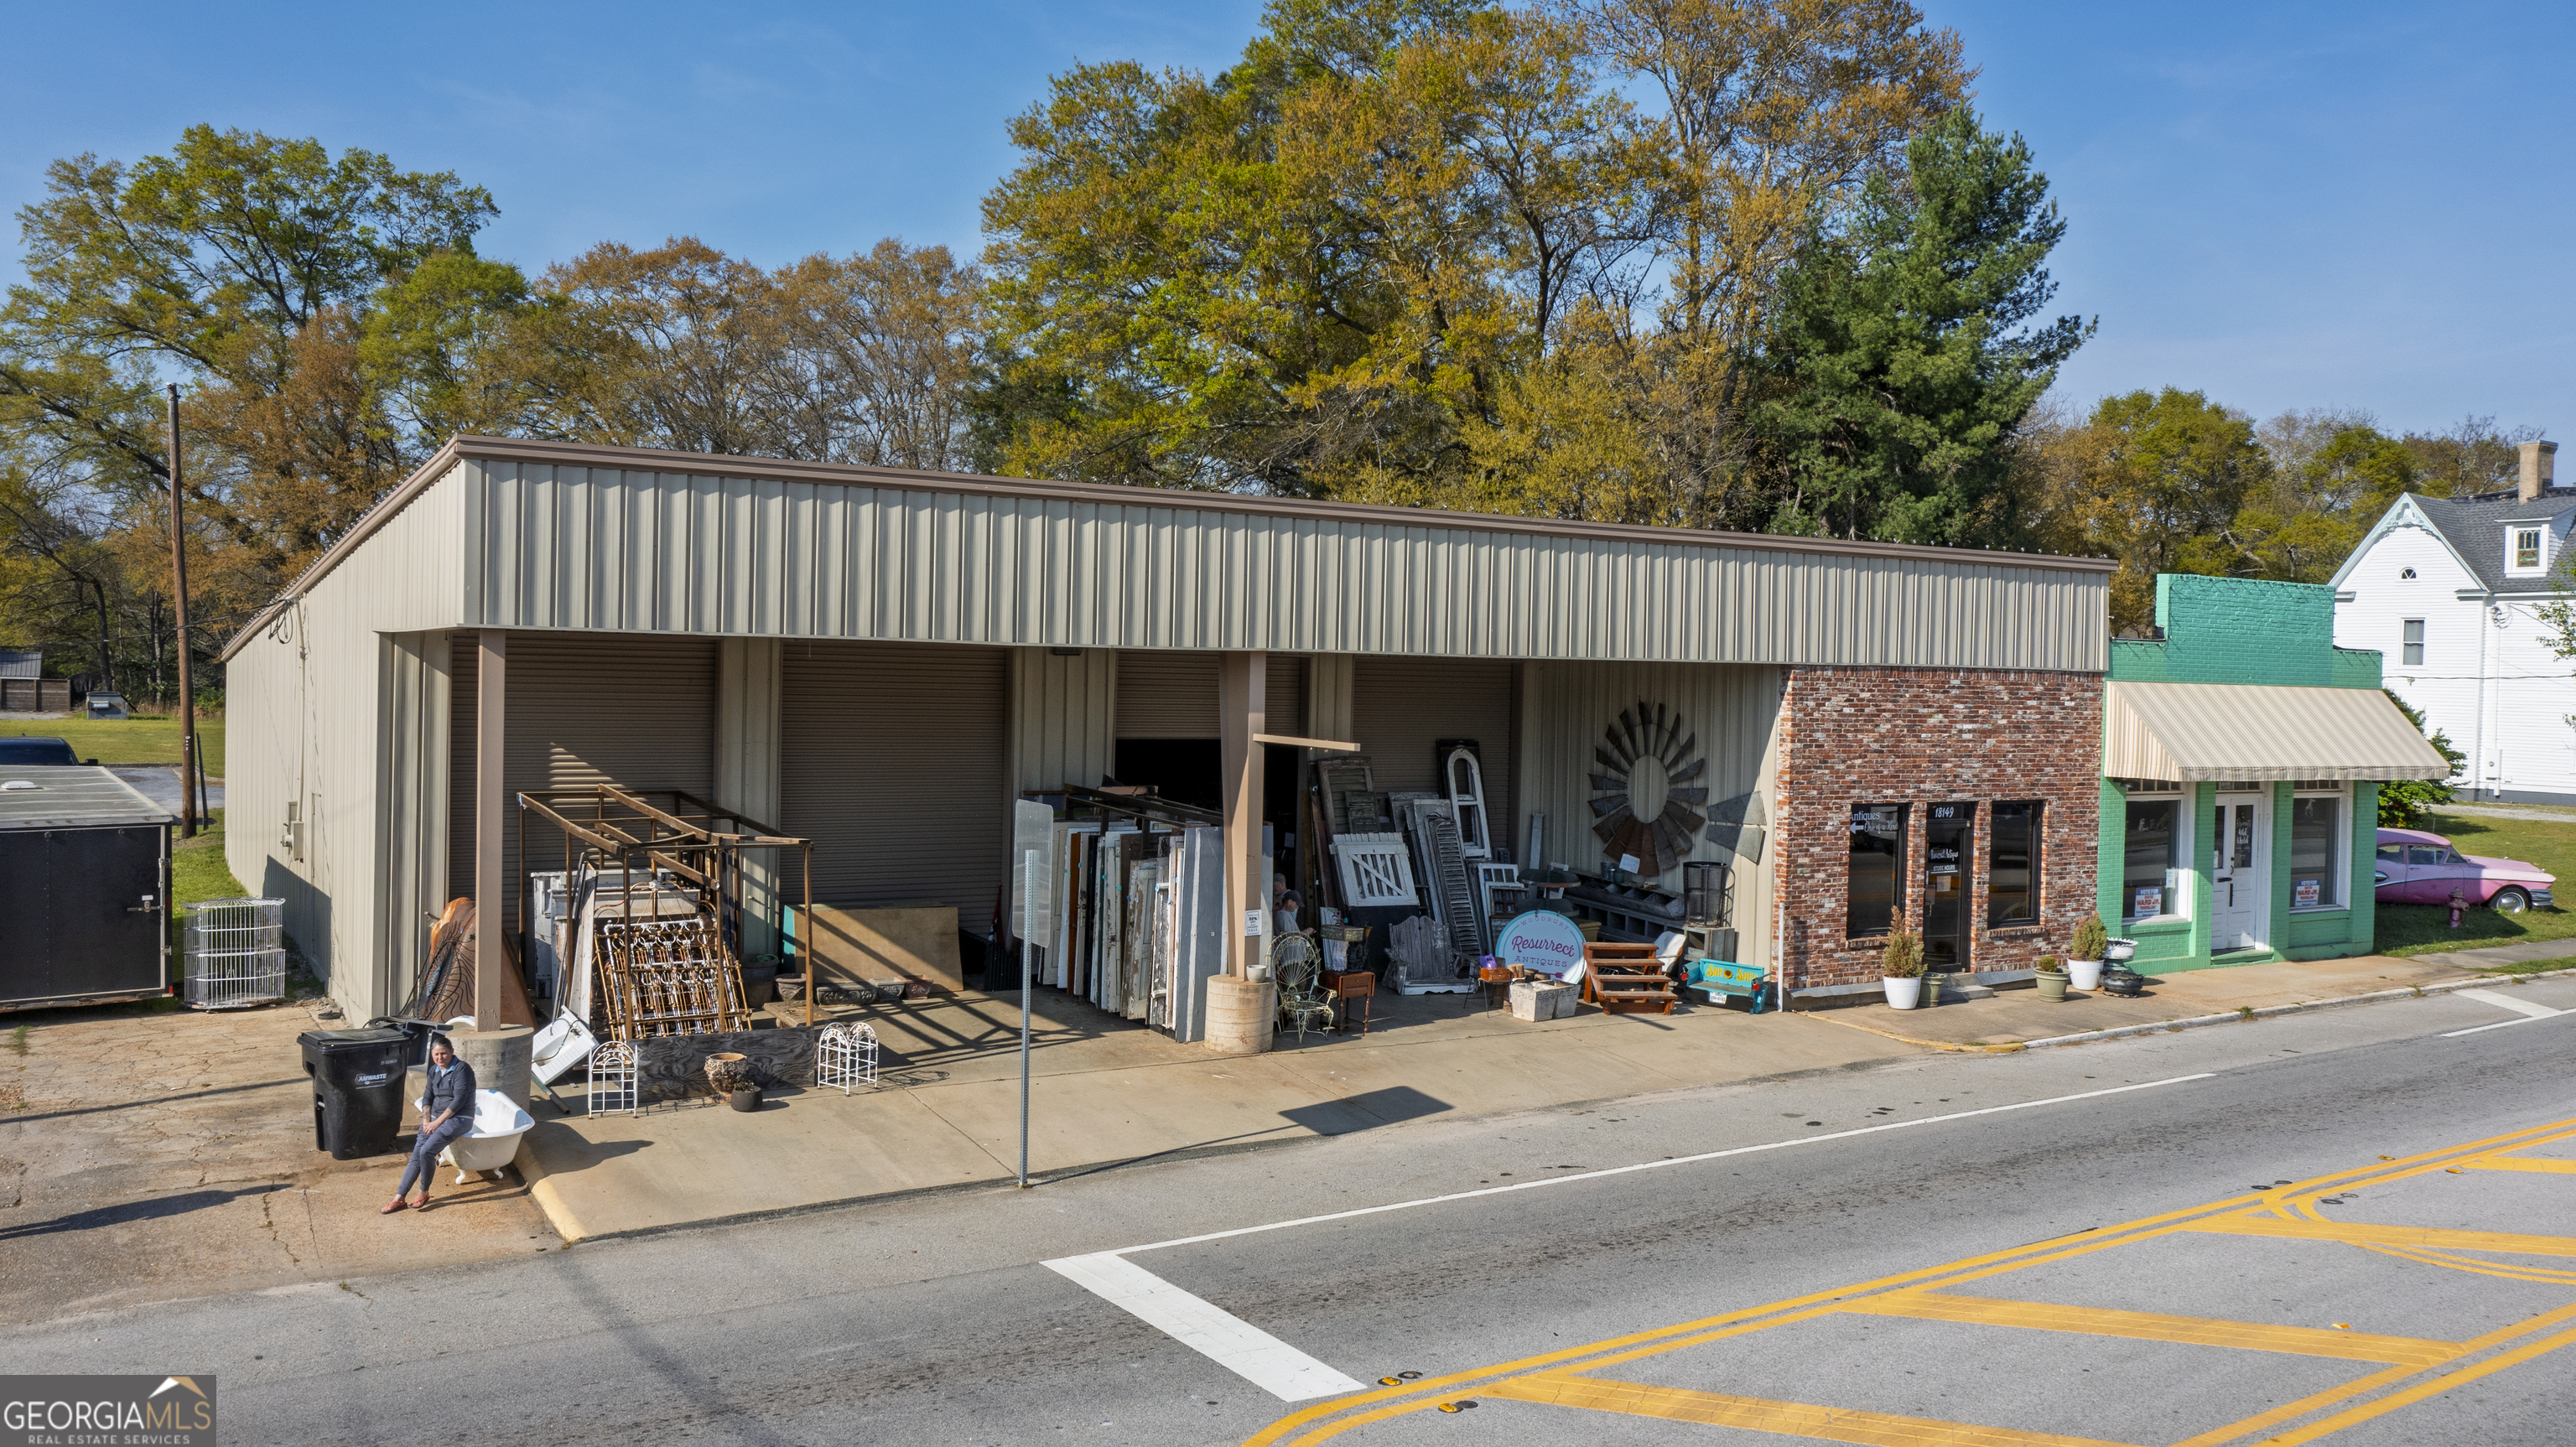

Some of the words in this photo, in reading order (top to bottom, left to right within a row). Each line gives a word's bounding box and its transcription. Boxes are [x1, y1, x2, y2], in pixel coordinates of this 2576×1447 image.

[1850, 810, 1880, 822] Antiques
[1935, 806, 1955, 818] 18149
[1520, 915, 1570, 930] WOODBURY
[1511, 935, 1575, 957] Resurrect
[1514, 955, 1567, 967] ANTIQUES
[358, 1073, 387, 1082] AMWASTE
